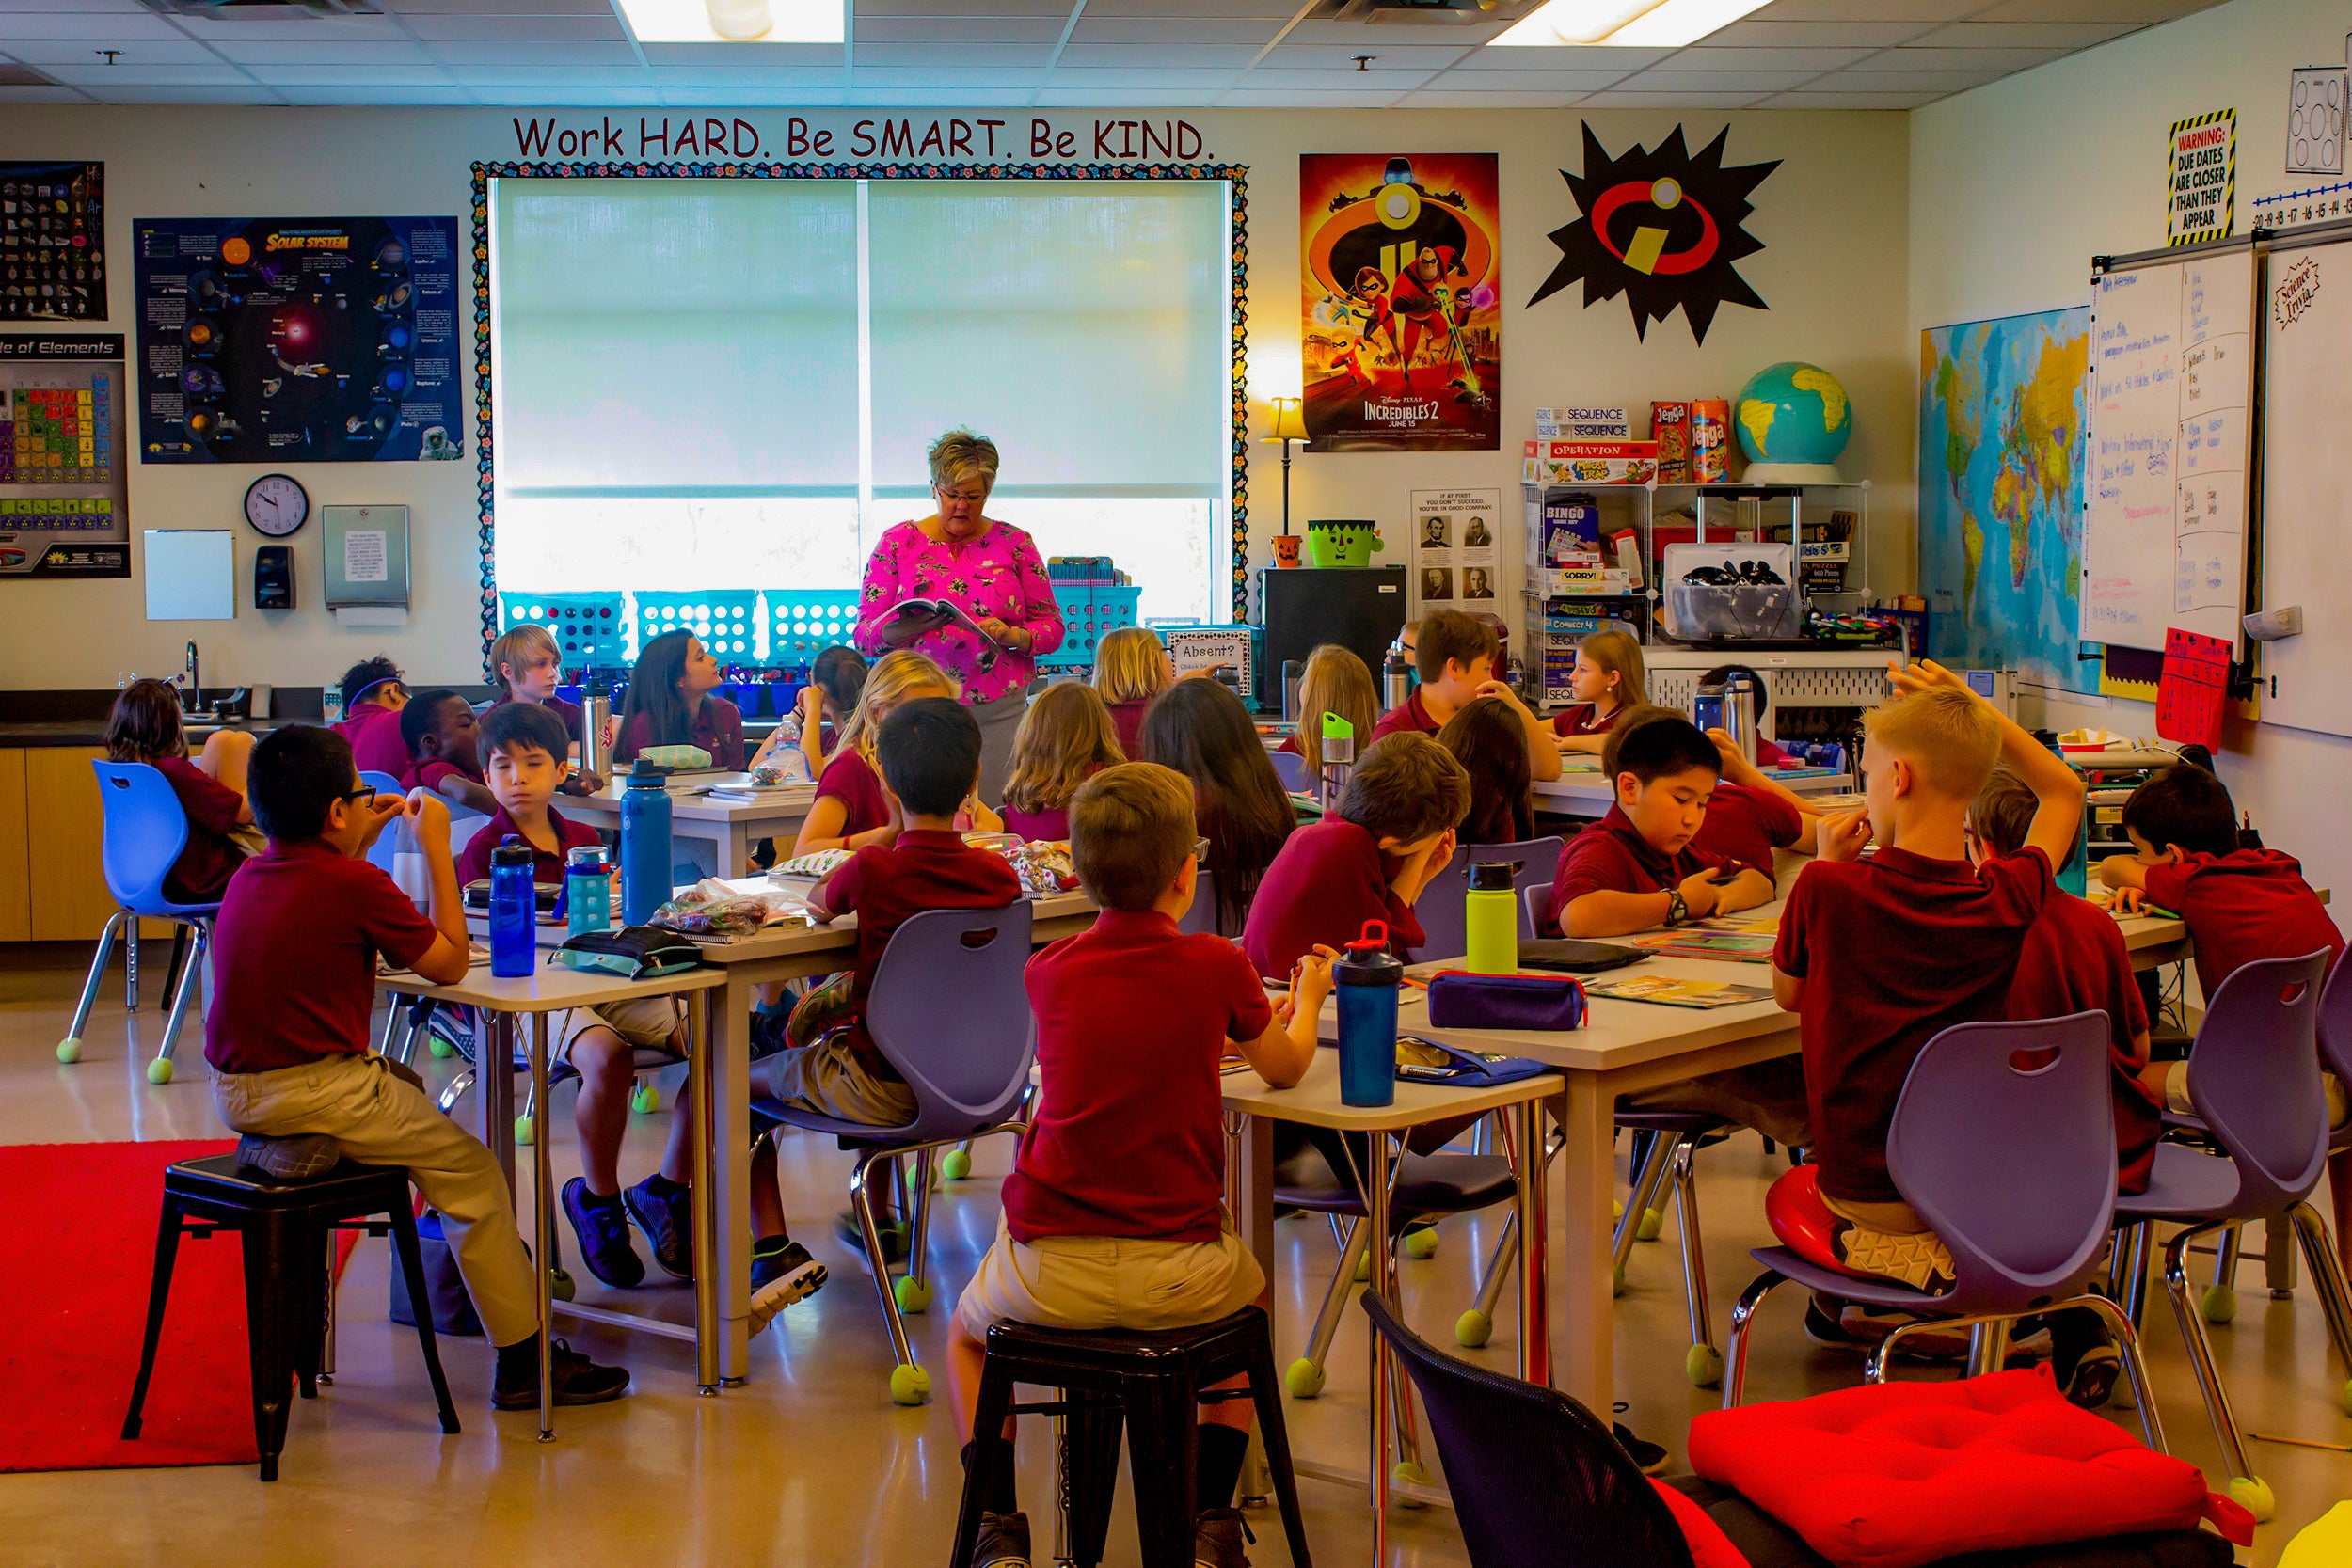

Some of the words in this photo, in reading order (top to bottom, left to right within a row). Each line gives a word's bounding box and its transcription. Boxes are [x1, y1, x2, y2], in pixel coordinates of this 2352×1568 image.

[513, 116, 624, 158] Work
[640, 117, 770, 159] HARD.
[787, 117, 835, 158] Be
[850, 119, 1012, 159] SMART.
[1031, 119, 1077, 158] Be
[1094, 119, 1215, 160] KIND.
[2178, 127, 2226, 151] WARNING:
[2178, 153, 2194, 171] DUE
[2197, 147, 2223, 167] DATES
[2175, 173, 2190, 192] ARE
[2192, 166, 2225, 188] CLOSER
[2176, 192, 2200, 212] THAN
[2201, 187, 2223, 207] THEY
[2183, 209, 2215, 230] APPEAR
[2287, 208, 2297, 223] -17
[2302, 205, 2312, 220] -16
[2315, 203, 2325, 218] -15
[2329, 199, 2339, 215] -14
[2282, 268, 2310, 301] Science
[2283, 288, 2312, 318] Trivia
[18, 341, 35, 354] of
[39, 341, 115, 354] Elements
[1379, 395, 1401, 404] Disney
[1364, 400, 1429, 420] INCREDIBLES
[1431, 401, 1438, 420] 2
[1568, 409, 1623, 420] SEQUENCE
[1657, 405, 1685, 423] Jenga
[1574, 425, 1627, 436] SEQUENCE
[1692, 424, 1724, 449] Jenga
[1553, 446, 1621, 455] OPERATION
[1576, 461, 1606, 470] MOUSE
[1581, 469, 1608, 482] TRAP
[1546, 507, 1585, 519] BINGO
[1585, 620, 1594, 630] 4
[1183, 645, 1234, 657] Absent?
